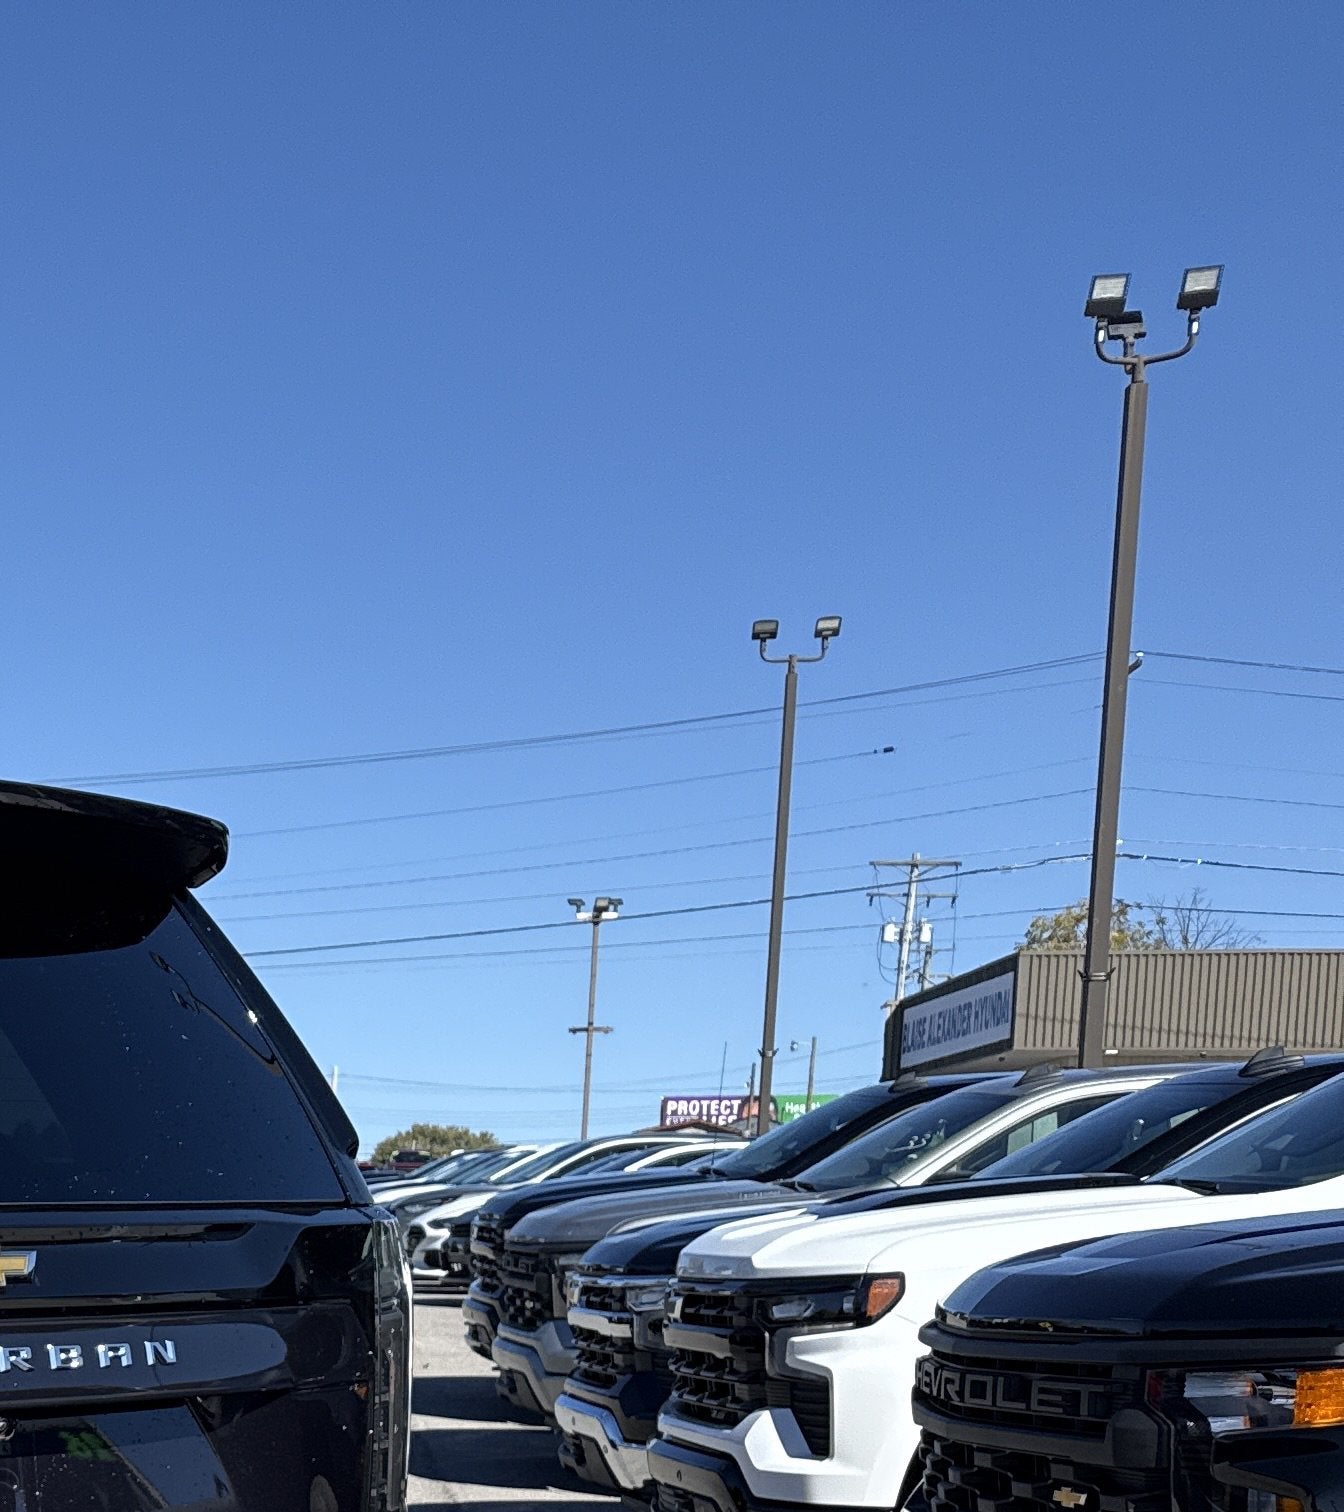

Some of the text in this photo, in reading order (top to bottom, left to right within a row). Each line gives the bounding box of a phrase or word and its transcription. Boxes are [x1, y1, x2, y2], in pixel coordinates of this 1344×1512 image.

[902, 988, 1011, 1055] BLAISE ALEXANDER HYUNDAI
[666, 1099, 742, 1116] PROTECT
[916, 1359, 1105, 1416] HEVROLET
